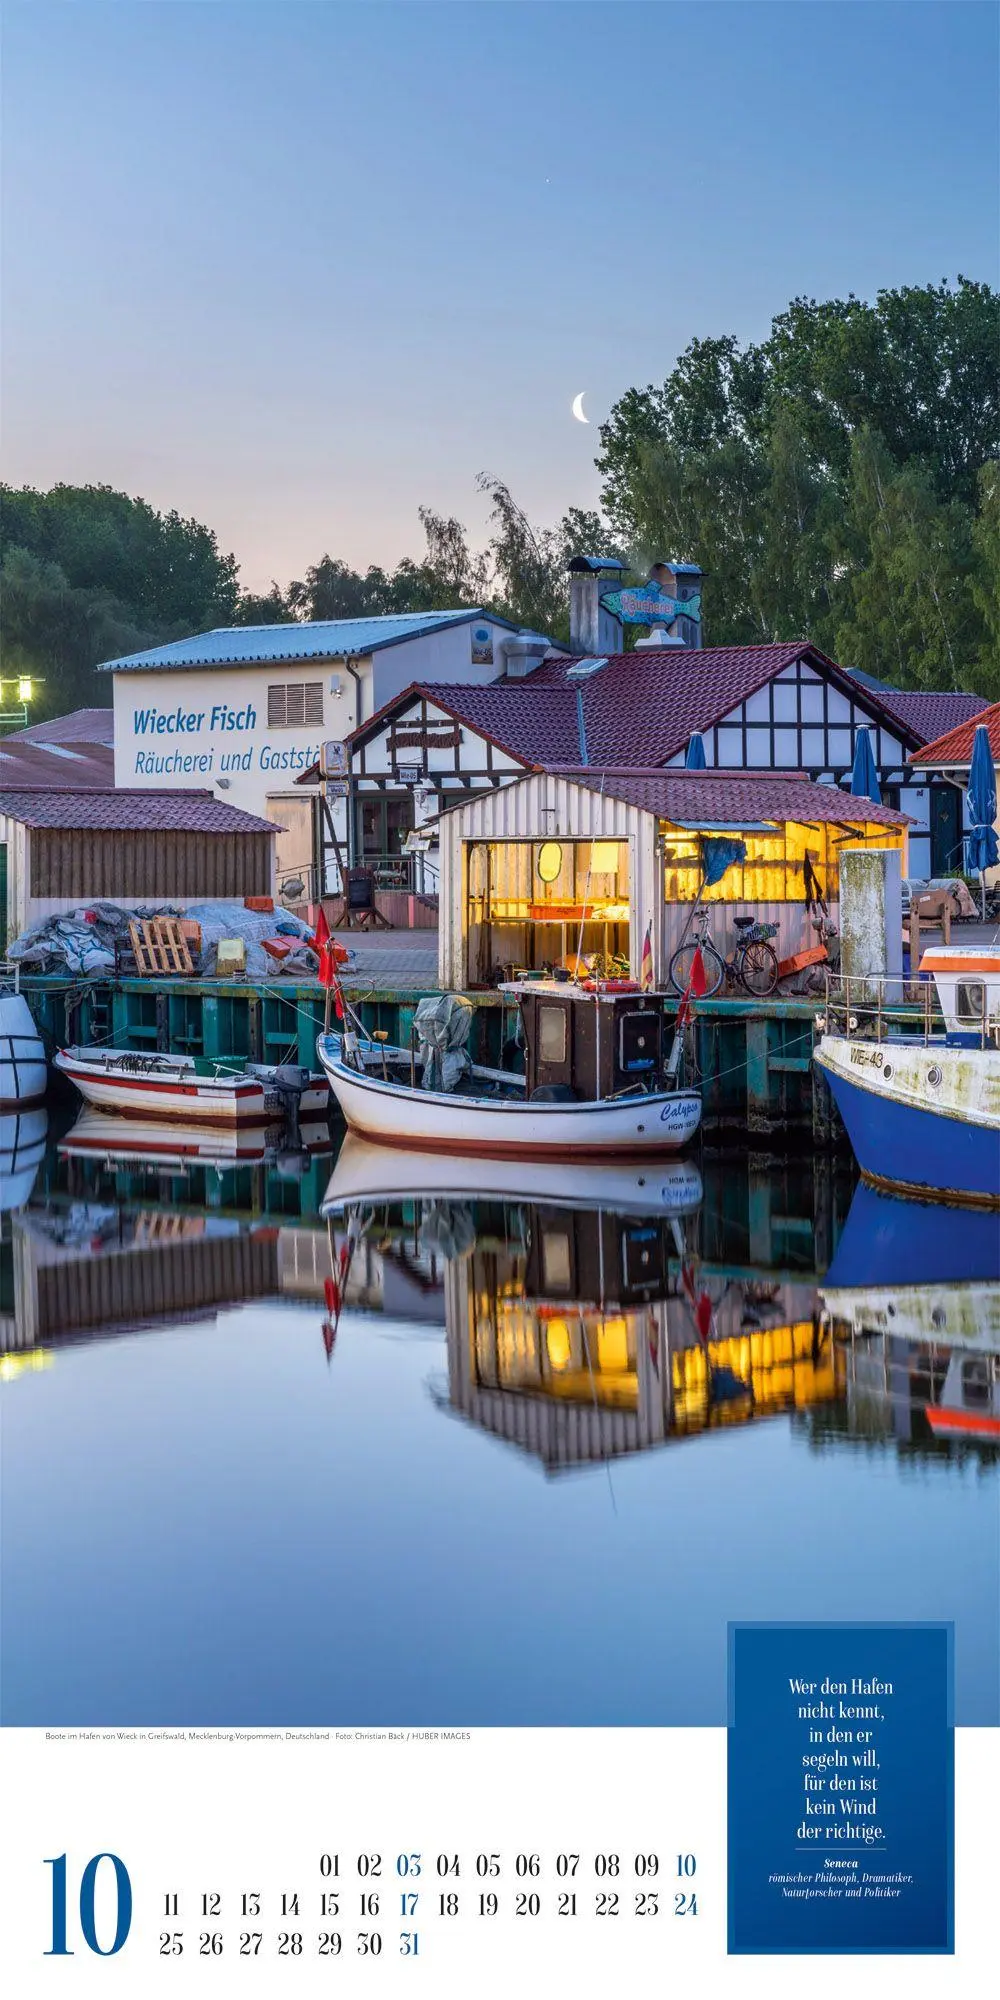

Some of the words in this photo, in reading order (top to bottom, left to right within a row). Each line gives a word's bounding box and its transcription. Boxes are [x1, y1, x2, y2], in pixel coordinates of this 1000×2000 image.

[134, 707, 205, 735] Wiecker
[209, 704, 257, 731] Fisch
[135, 747, 214, 774] Räucherei
[220, 747, 253, 771] und
